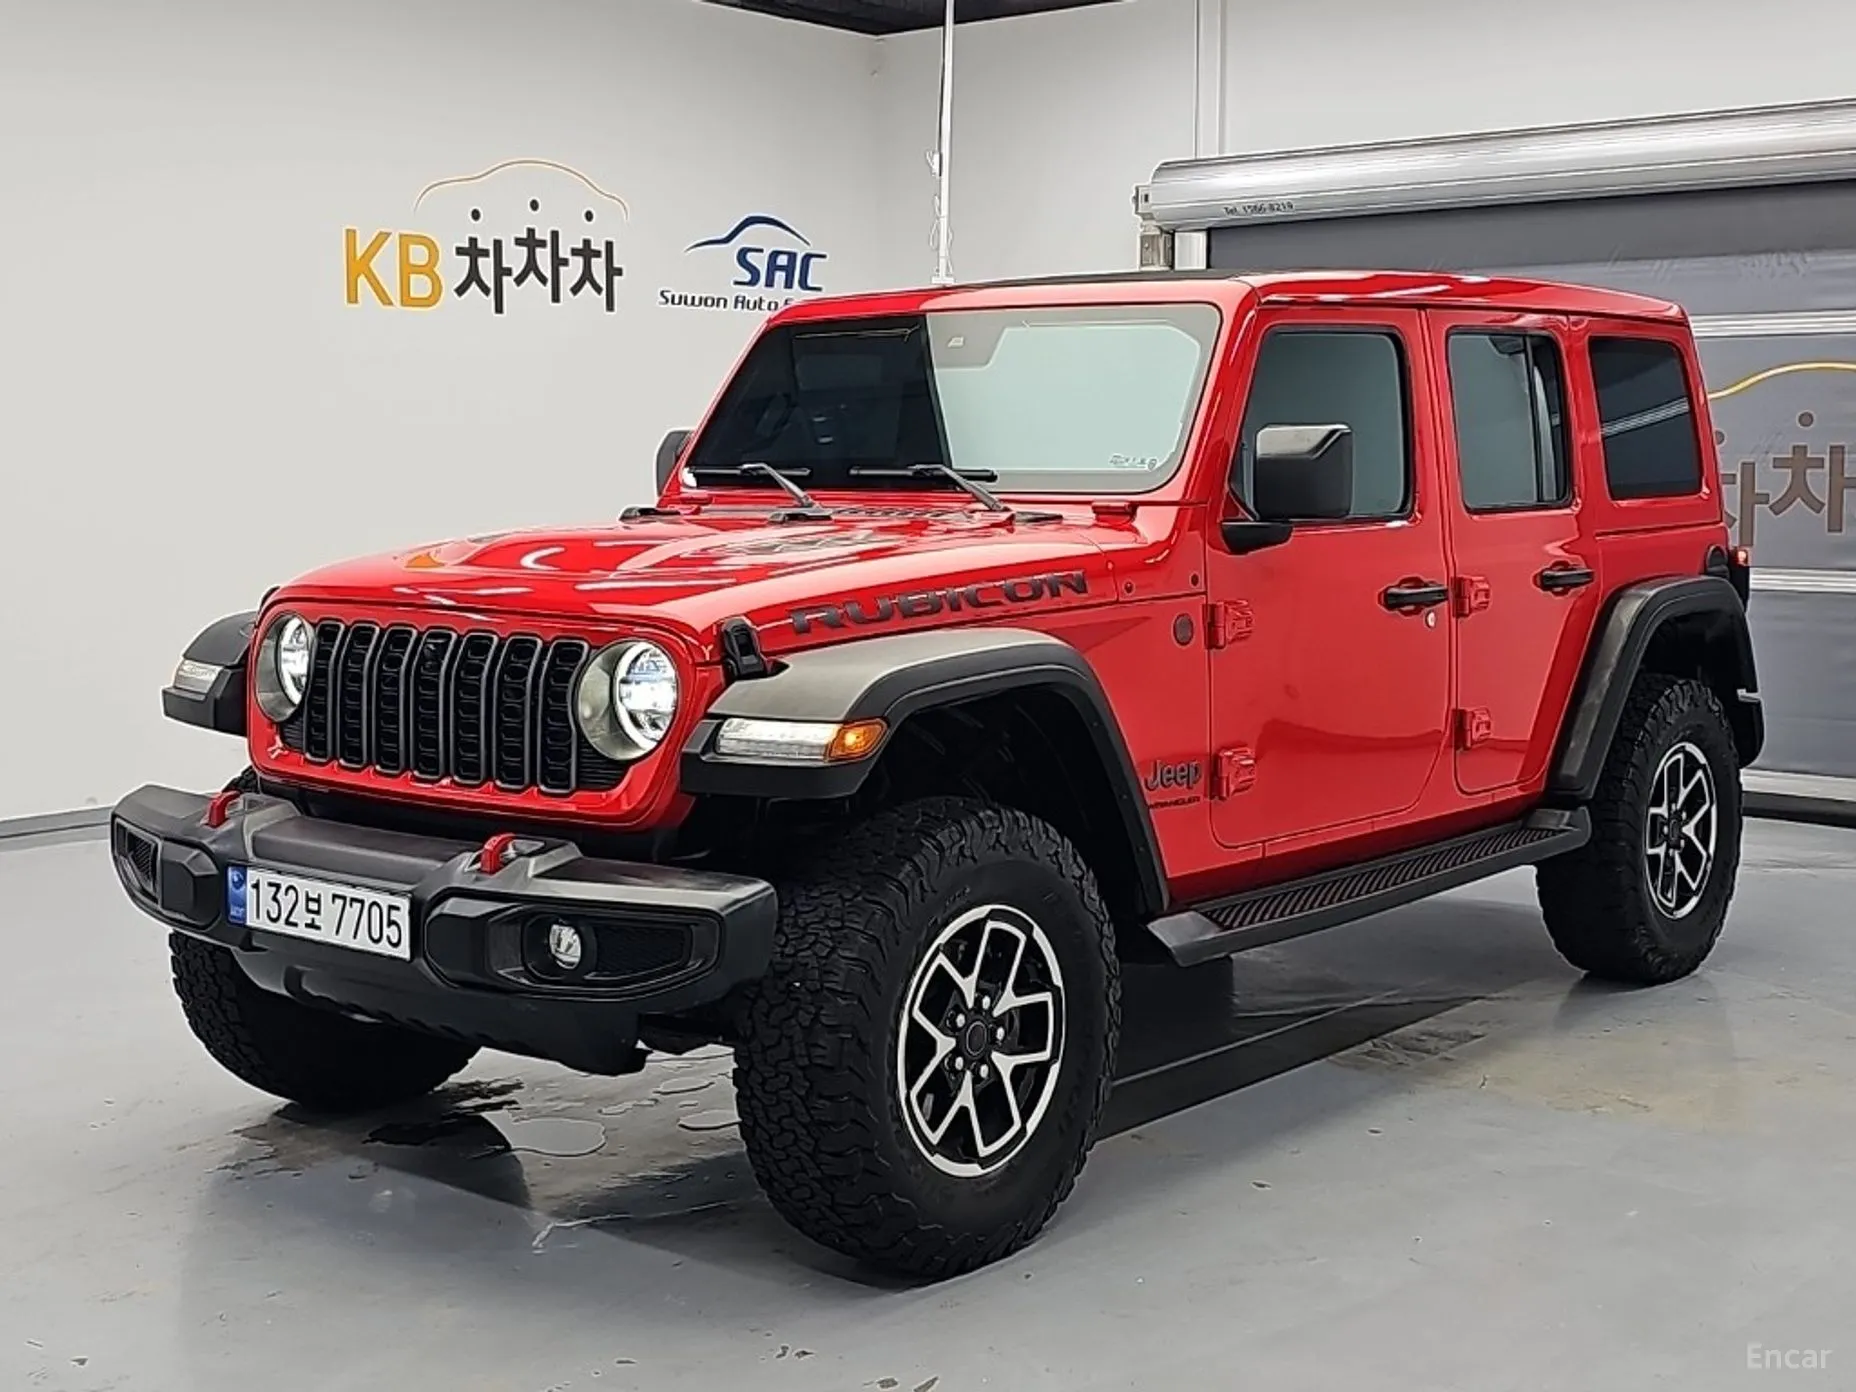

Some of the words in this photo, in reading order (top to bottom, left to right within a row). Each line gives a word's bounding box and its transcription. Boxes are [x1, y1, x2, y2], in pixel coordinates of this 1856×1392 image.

[733, 246, 827, 292] SAC
[658, 289, 728, 309] Suwon
[733, 295, 779, 312] Auto
[790, 570, 1089, 635] RUBICON
[1144, 759, 1202, 792] Jeep
[331, 893, 402, 949] 7705
